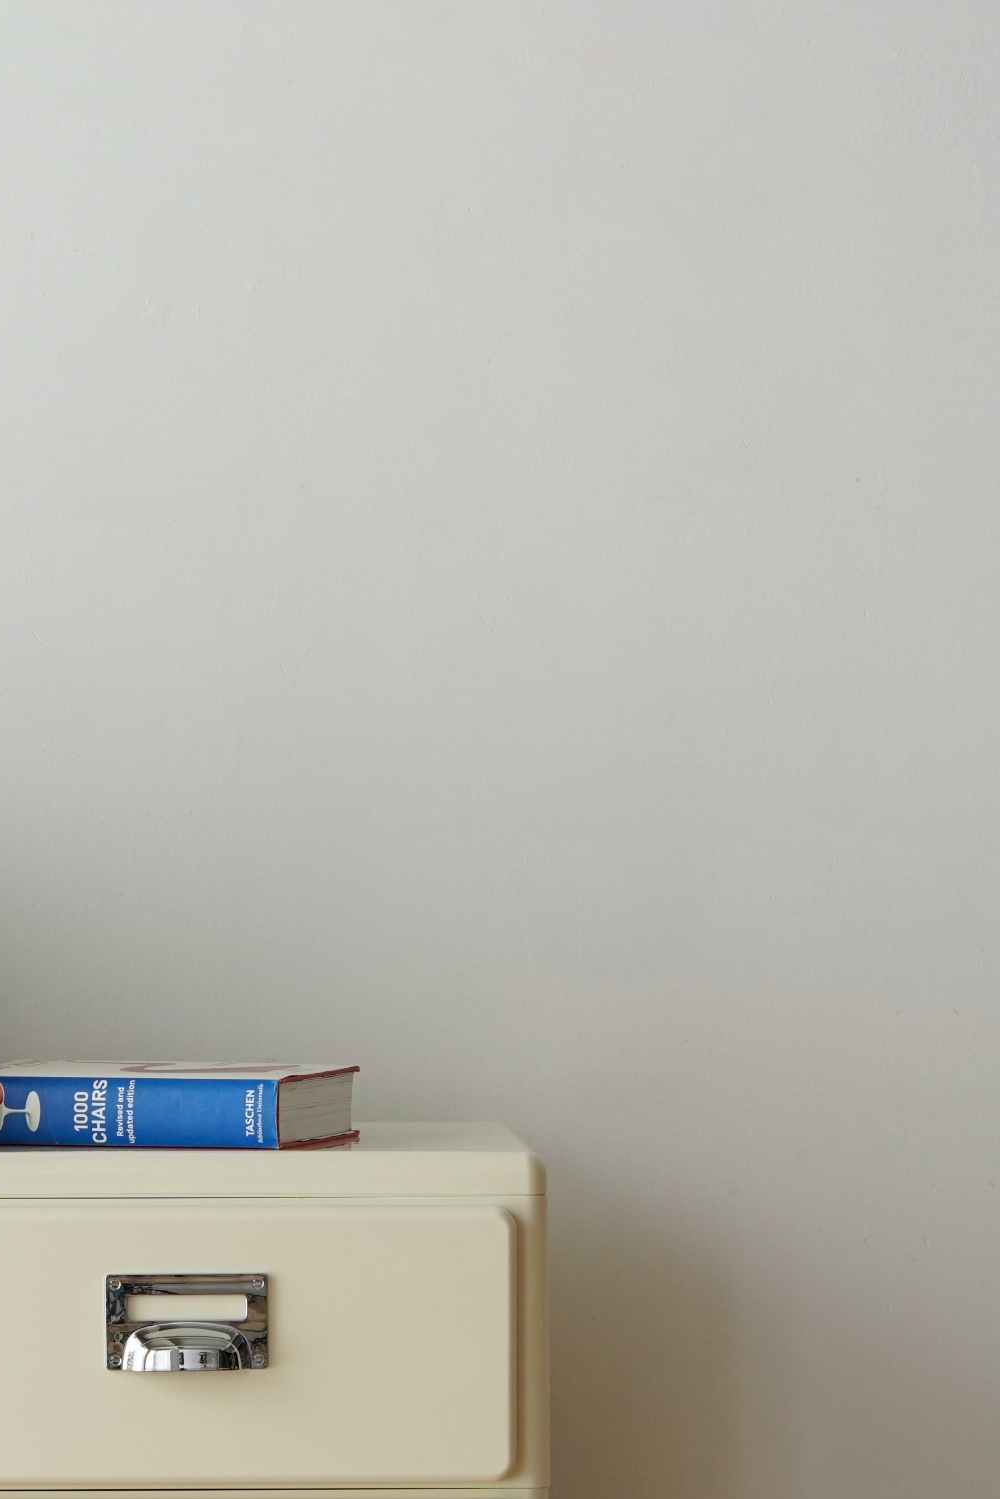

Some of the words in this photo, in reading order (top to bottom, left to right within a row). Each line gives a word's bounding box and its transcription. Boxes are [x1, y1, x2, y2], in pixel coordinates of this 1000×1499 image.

[117, 1086, 125, 1103] and
[126, 1079, 136, 1109] edition
[73, 1091, 89, 1132] 1000
[91, 1079, 108, 1144] CHAIRS
[116, 1104, 124, 1137] Revised
[126, 1110, 136, 1144] updated
[245, 1089, 255, 1137] TASCHEN
